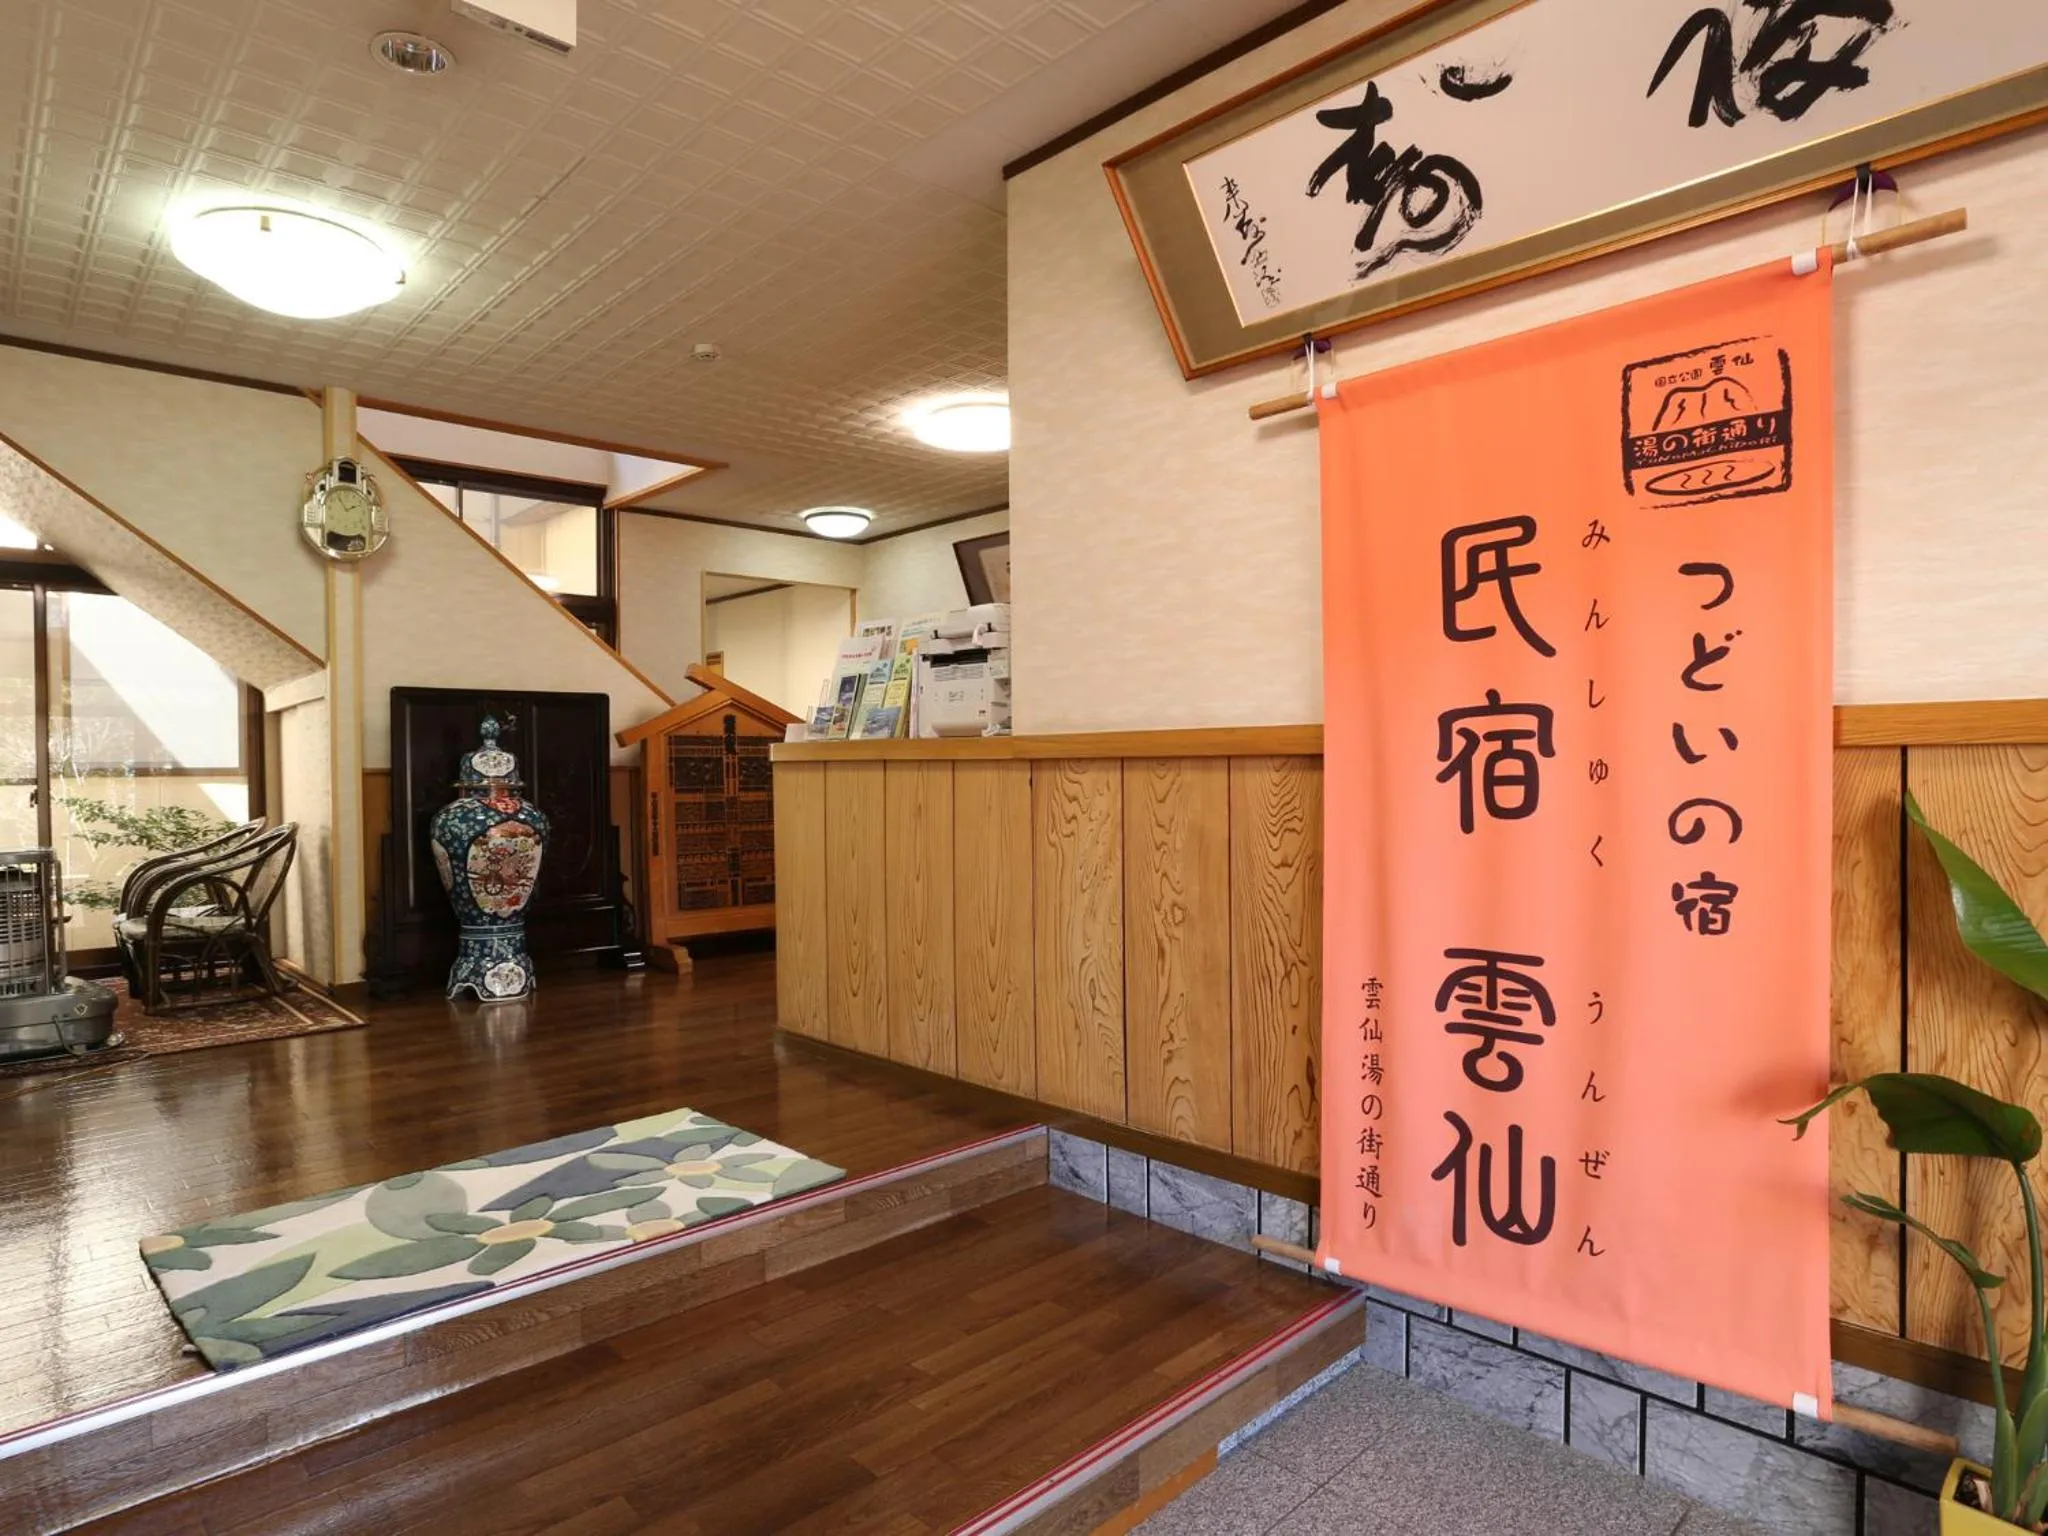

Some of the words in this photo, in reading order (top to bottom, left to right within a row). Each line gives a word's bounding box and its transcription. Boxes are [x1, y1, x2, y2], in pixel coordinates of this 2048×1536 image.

[1633, 417, 1776, 457] 湯の街通り
[1709, 352, 1754, 376] 雲仙
[1436, 515, 1556, 835] 民宿
[1581, 519, 1611, 868] みんしゅく
[1667, 562, 1743, 936] つどいの宿
[1355, 976, 1385, 1230] 雲仙湯の街通り
[1431, 948, 1556, 1247] 雲仙
[1577, 991, 1611, 1257] うんぜん
